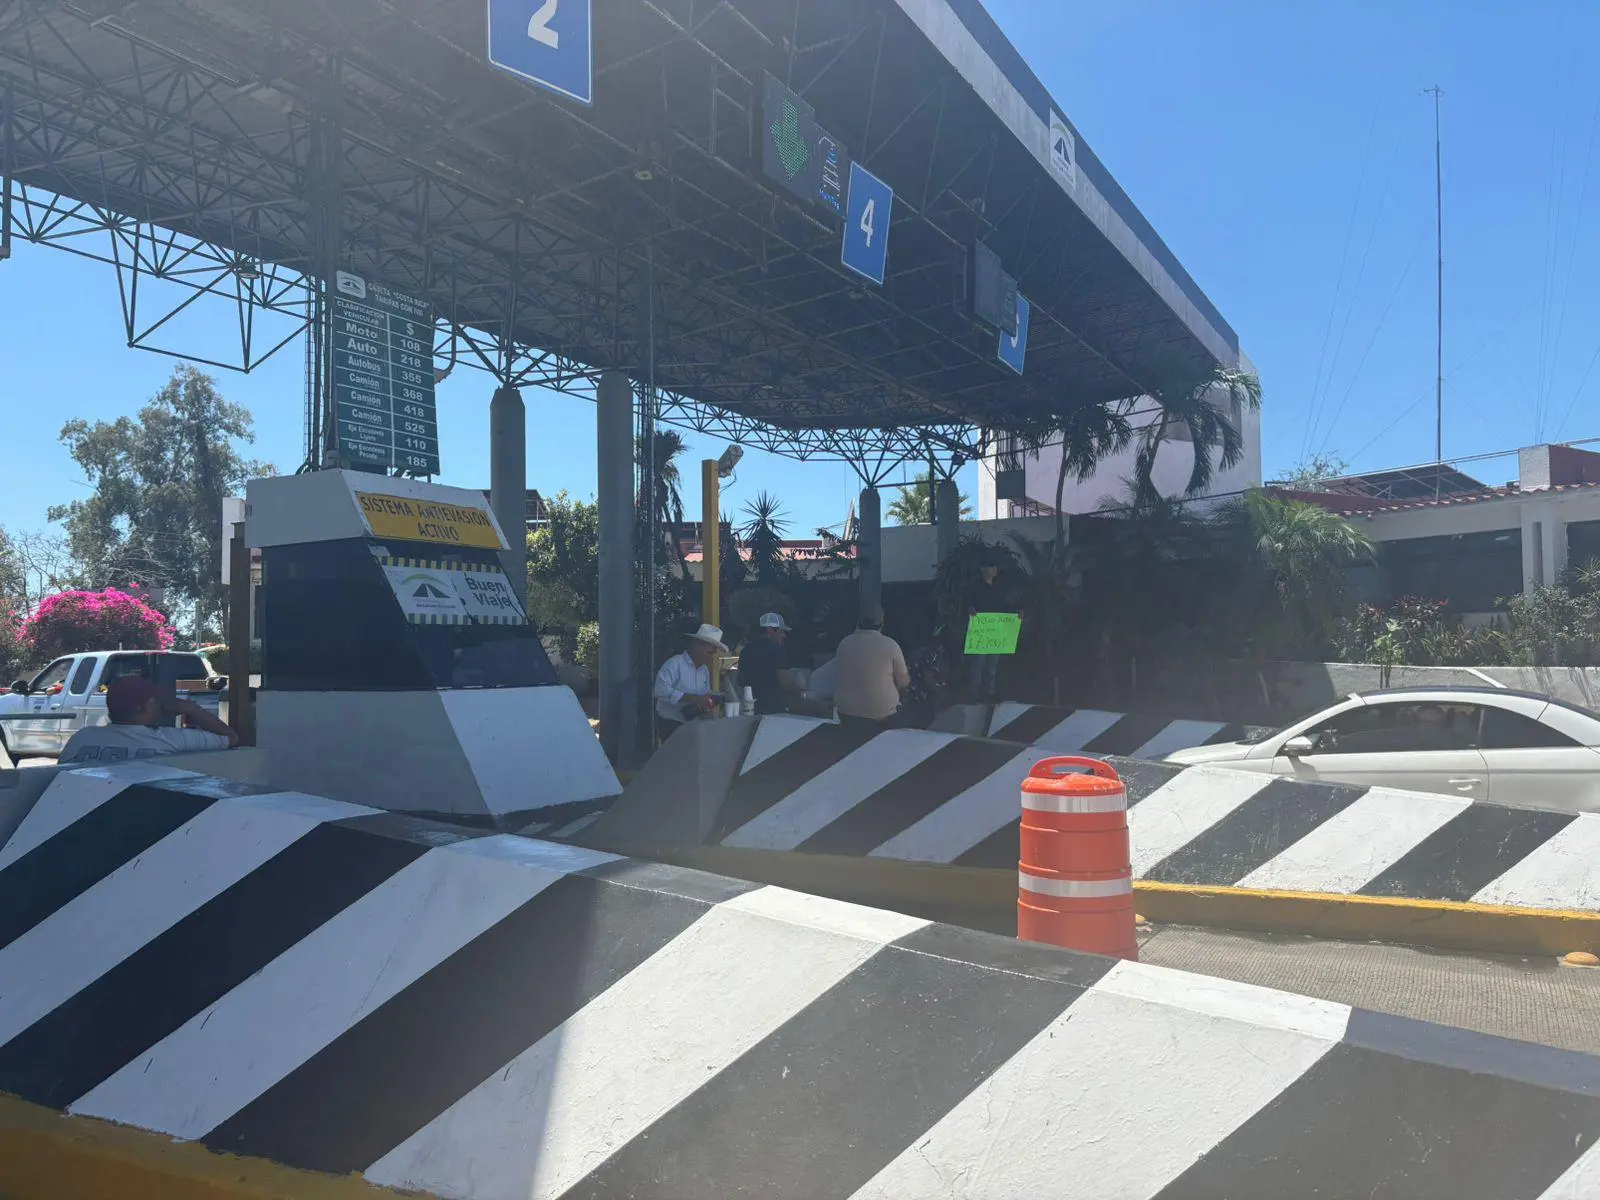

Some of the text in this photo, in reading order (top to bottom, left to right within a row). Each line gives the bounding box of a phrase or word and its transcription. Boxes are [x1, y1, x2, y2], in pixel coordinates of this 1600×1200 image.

[860, 198, 875, 248] 4
[346, 322, 378, 339] Moto
[406, 322, 414, 336] $
[347, 338, 378, 355] Auto
[401, 338, 420, 352] 108
[401, 354, 421, 368] 218
[349, 372, 380, 388] Camión
[402, 370, 422, 384] 355
[350, 390, 381, 405] Camión
[402, 388, 423, 401] 368
[352, 408, 382, 422] Camión
[404, 404, 424, 417] 418
[404, 422, 425, 434] 525
[406, 438, 426, 450] 110
[406, 456, 428, 468] 185
[360, 496, 492, 528] SISTEMA ANTIEVASION
[417, 522, 460, 541] ACTIVO
[466, 576, 506, 593] Buen
